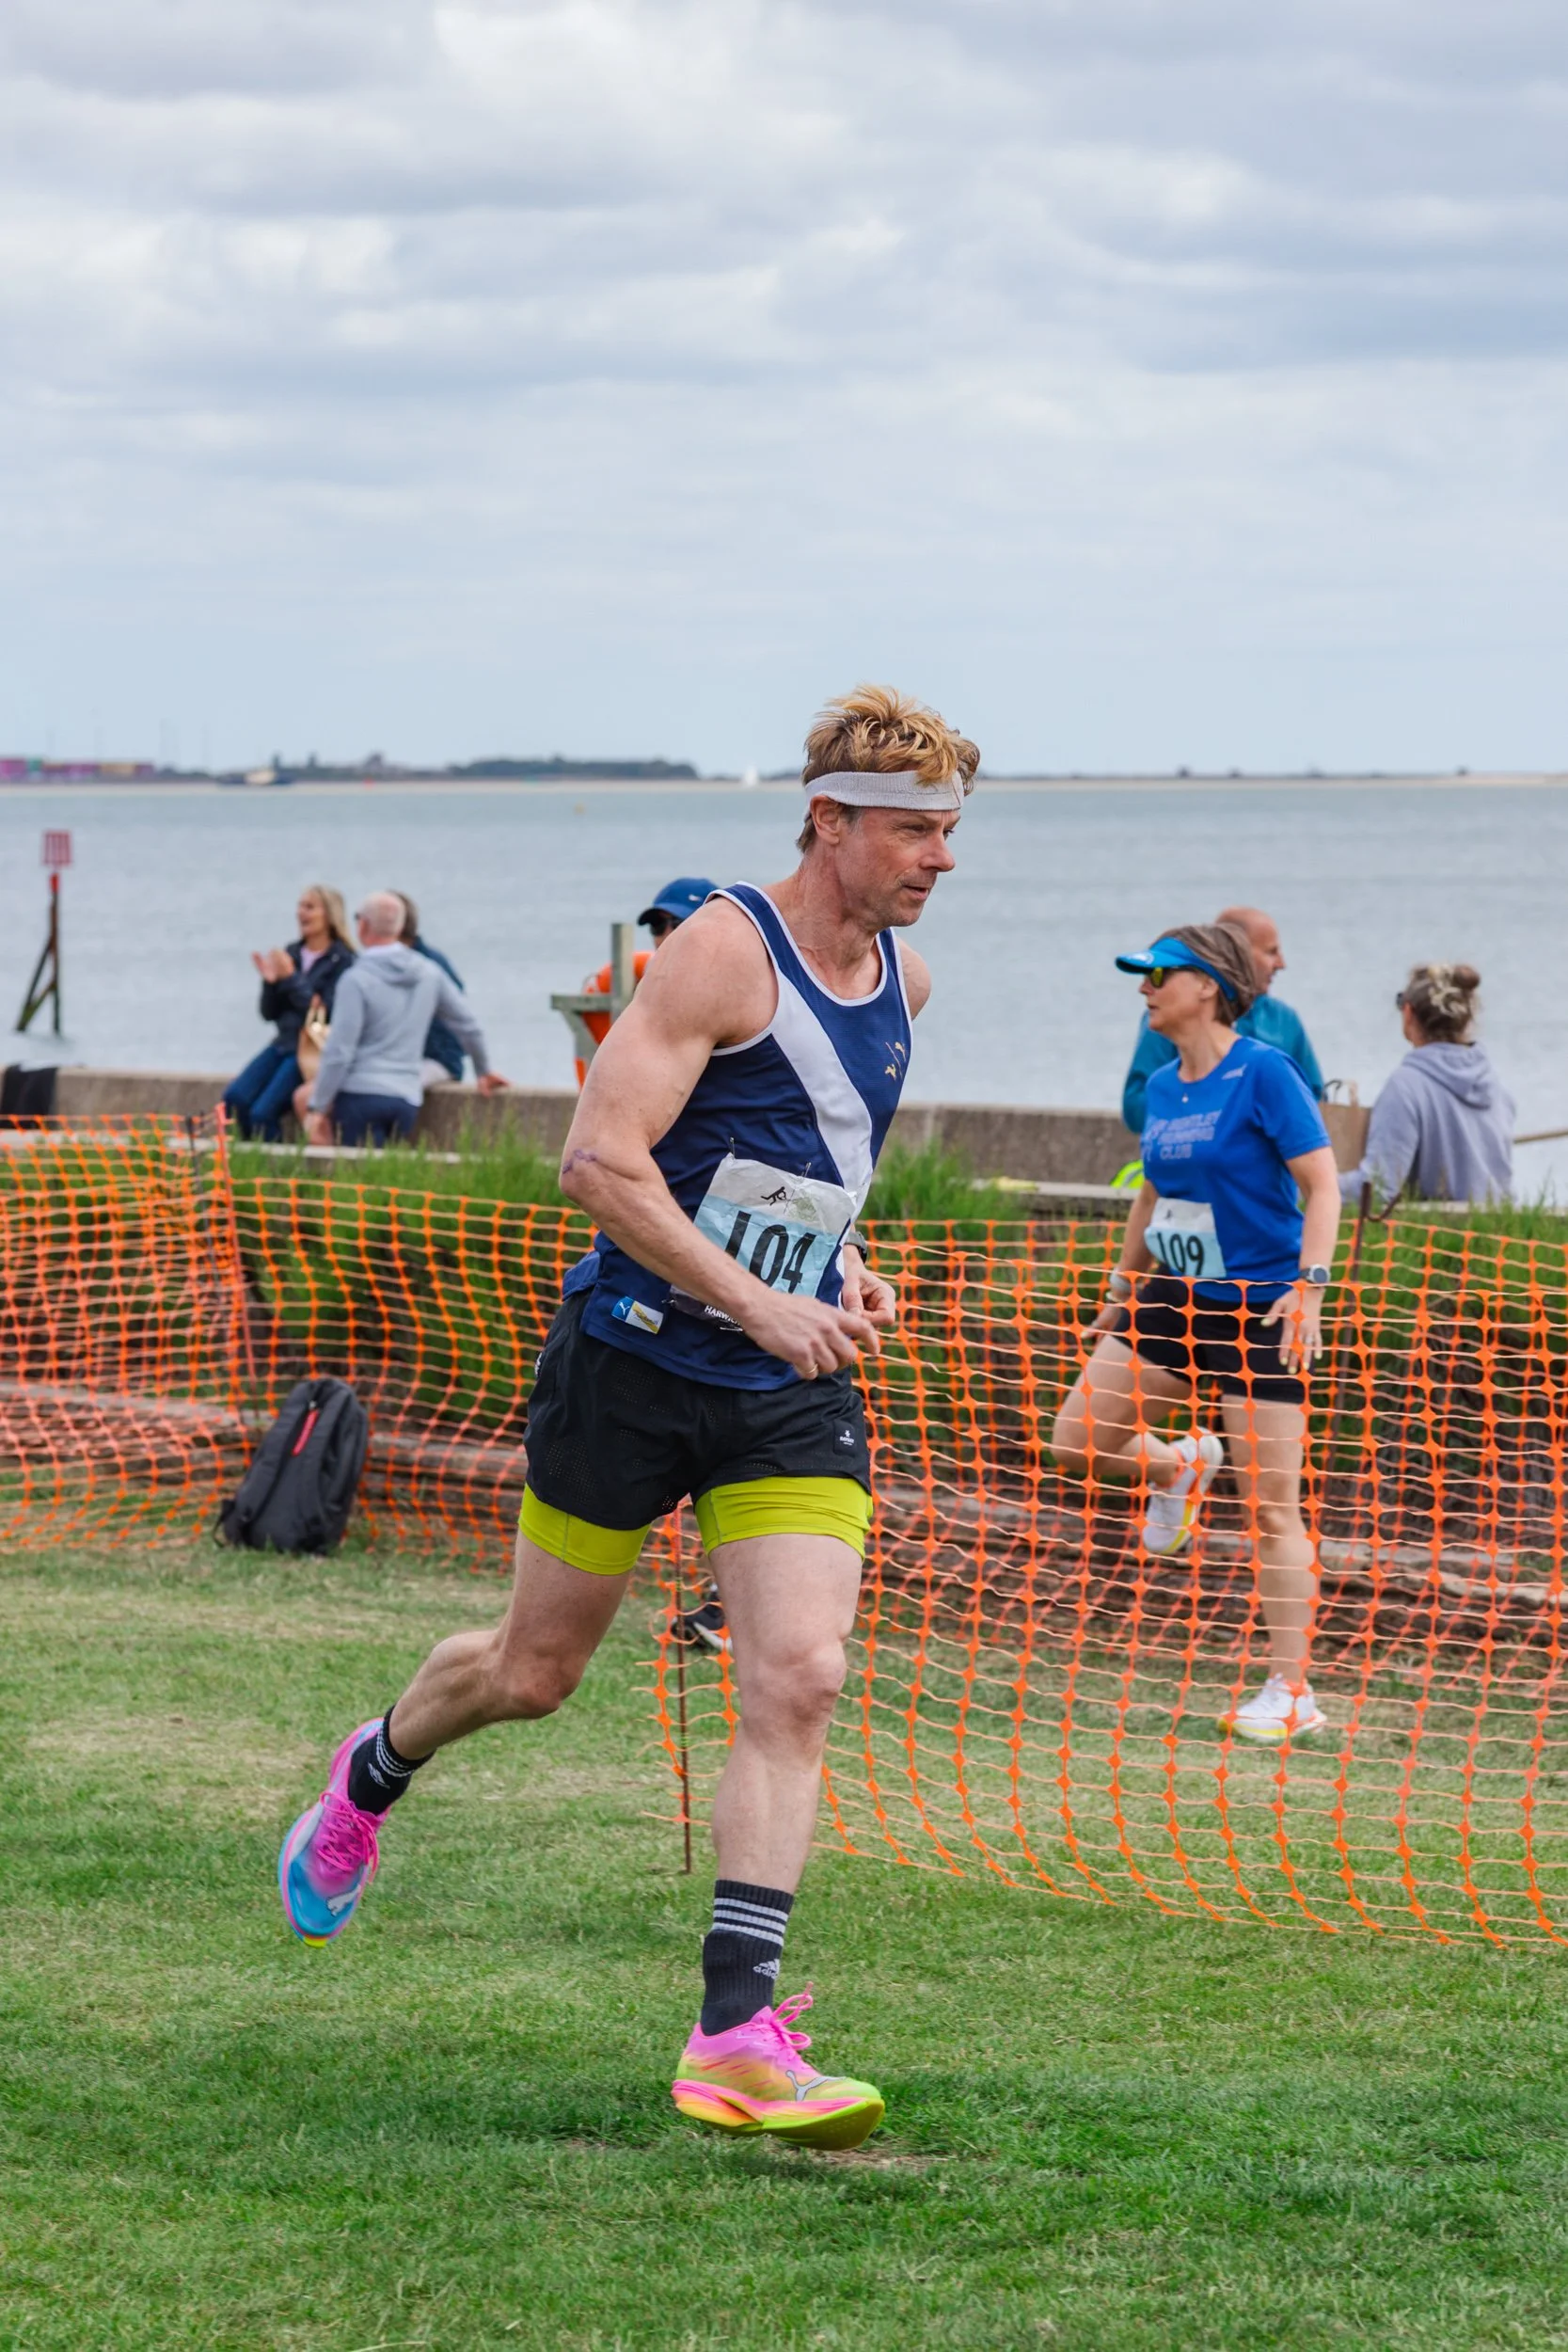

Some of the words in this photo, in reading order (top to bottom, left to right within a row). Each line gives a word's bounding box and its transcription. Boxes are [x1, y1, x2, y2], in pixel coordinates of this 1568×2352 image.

[724, 1210, 817, 1295] 104
[1157, 1232, 1205, 1277] 109
[704, 1304, 741, 1326] HARWIC
